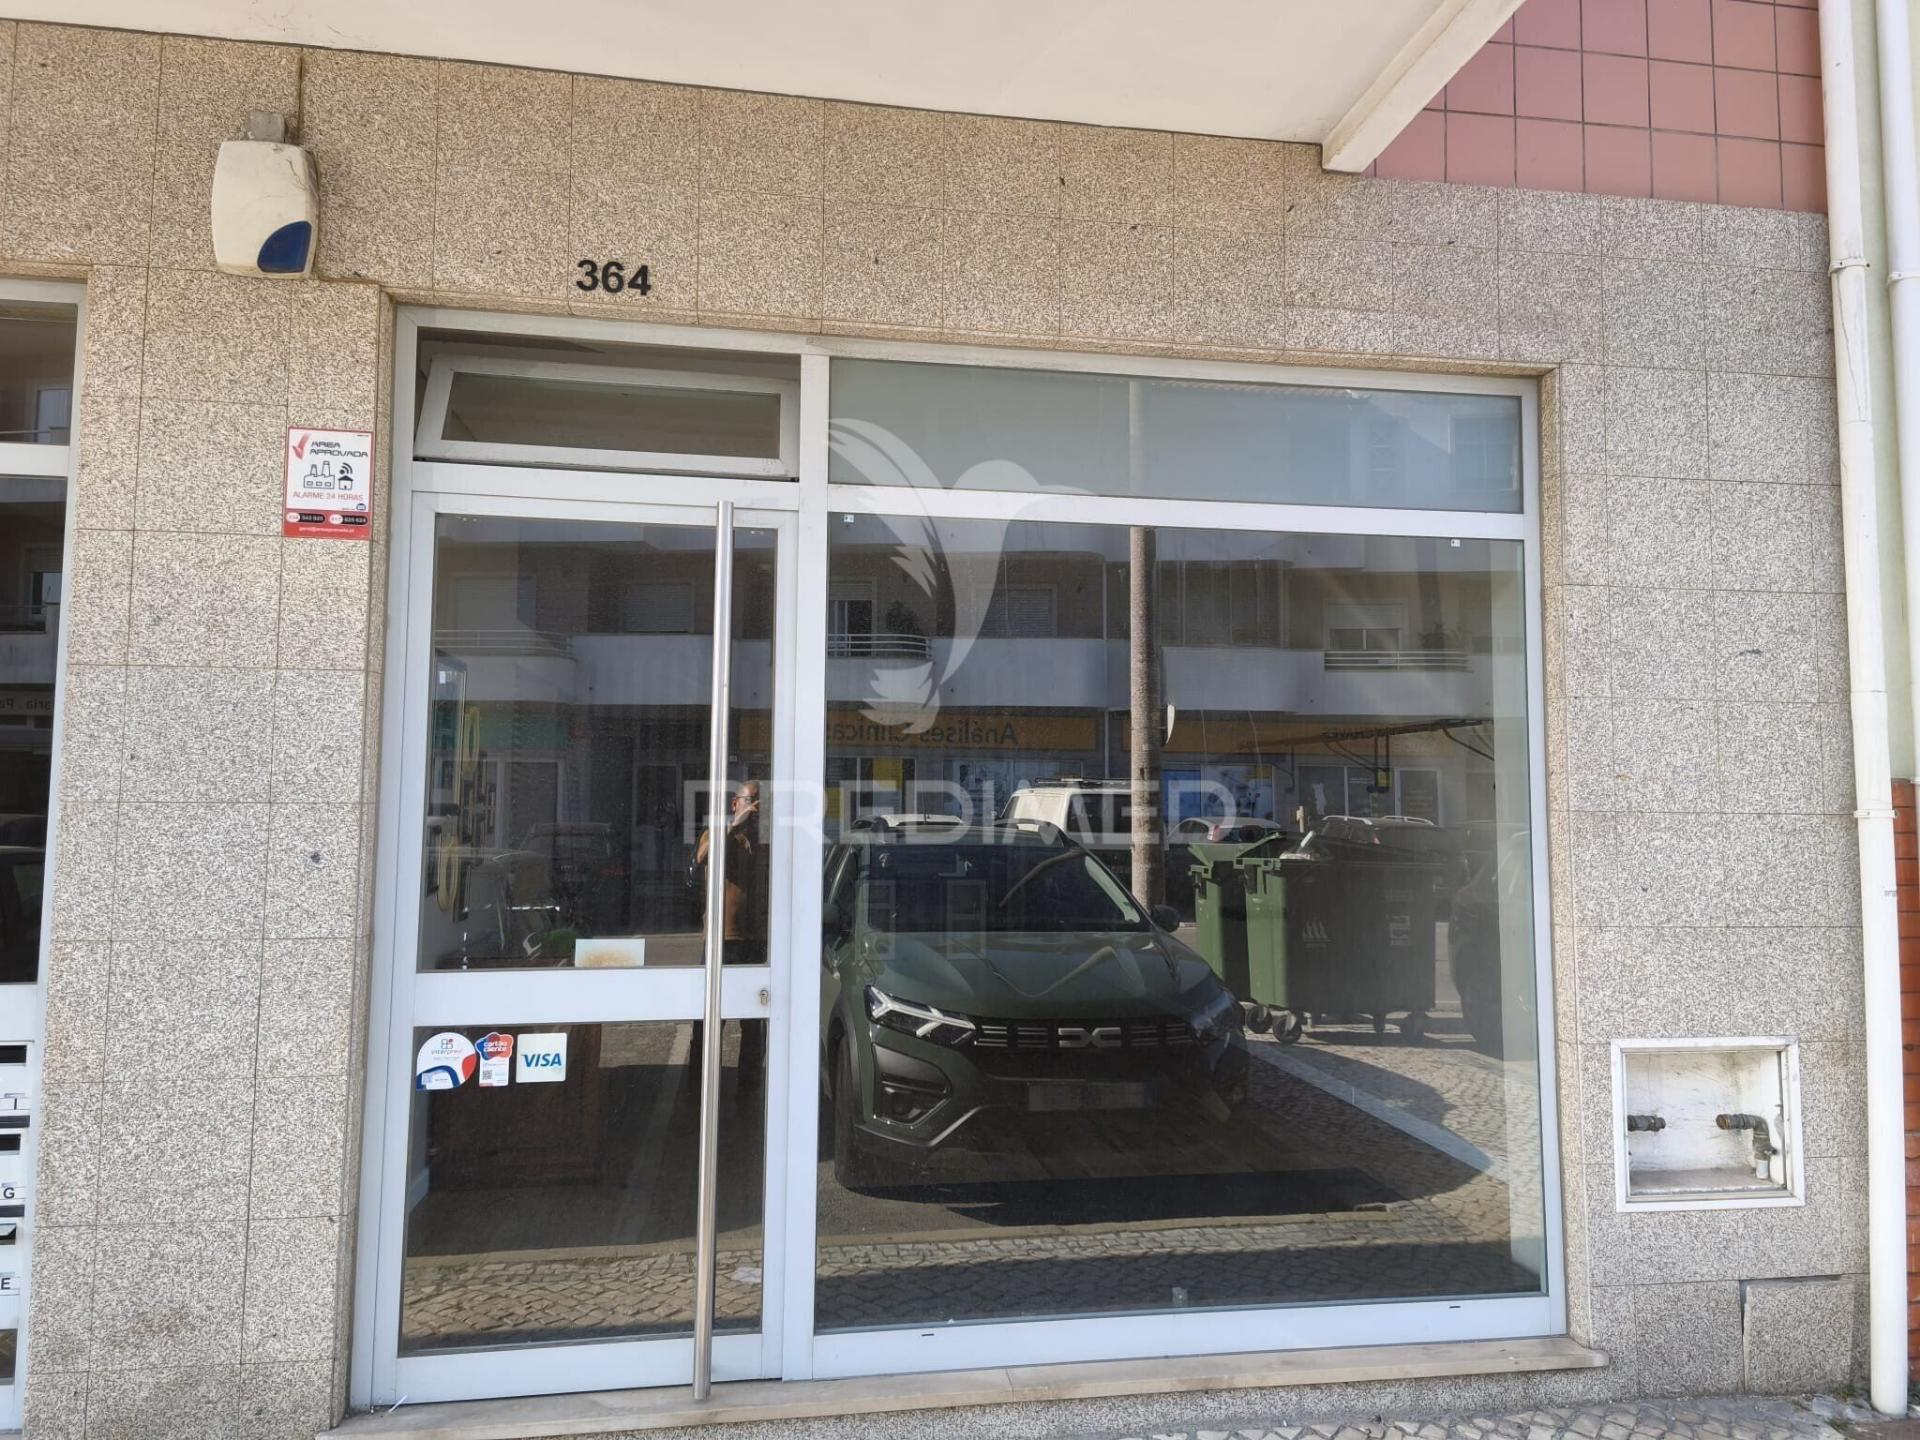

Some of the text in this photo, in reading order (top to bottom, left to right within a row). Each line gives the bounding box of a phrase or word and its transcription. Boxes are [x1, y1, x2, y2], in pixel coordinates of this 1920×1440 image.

[576, 260, 652, 296] 364
[309, 448, 369, 457] APROVADA
[293, 491, 364, 501] ALARME 24 HORAS
[521, 1053, 562, 1067] VISA
[3, 1187, 15, 1199] G
[1, 1277, 11, 1290] E
